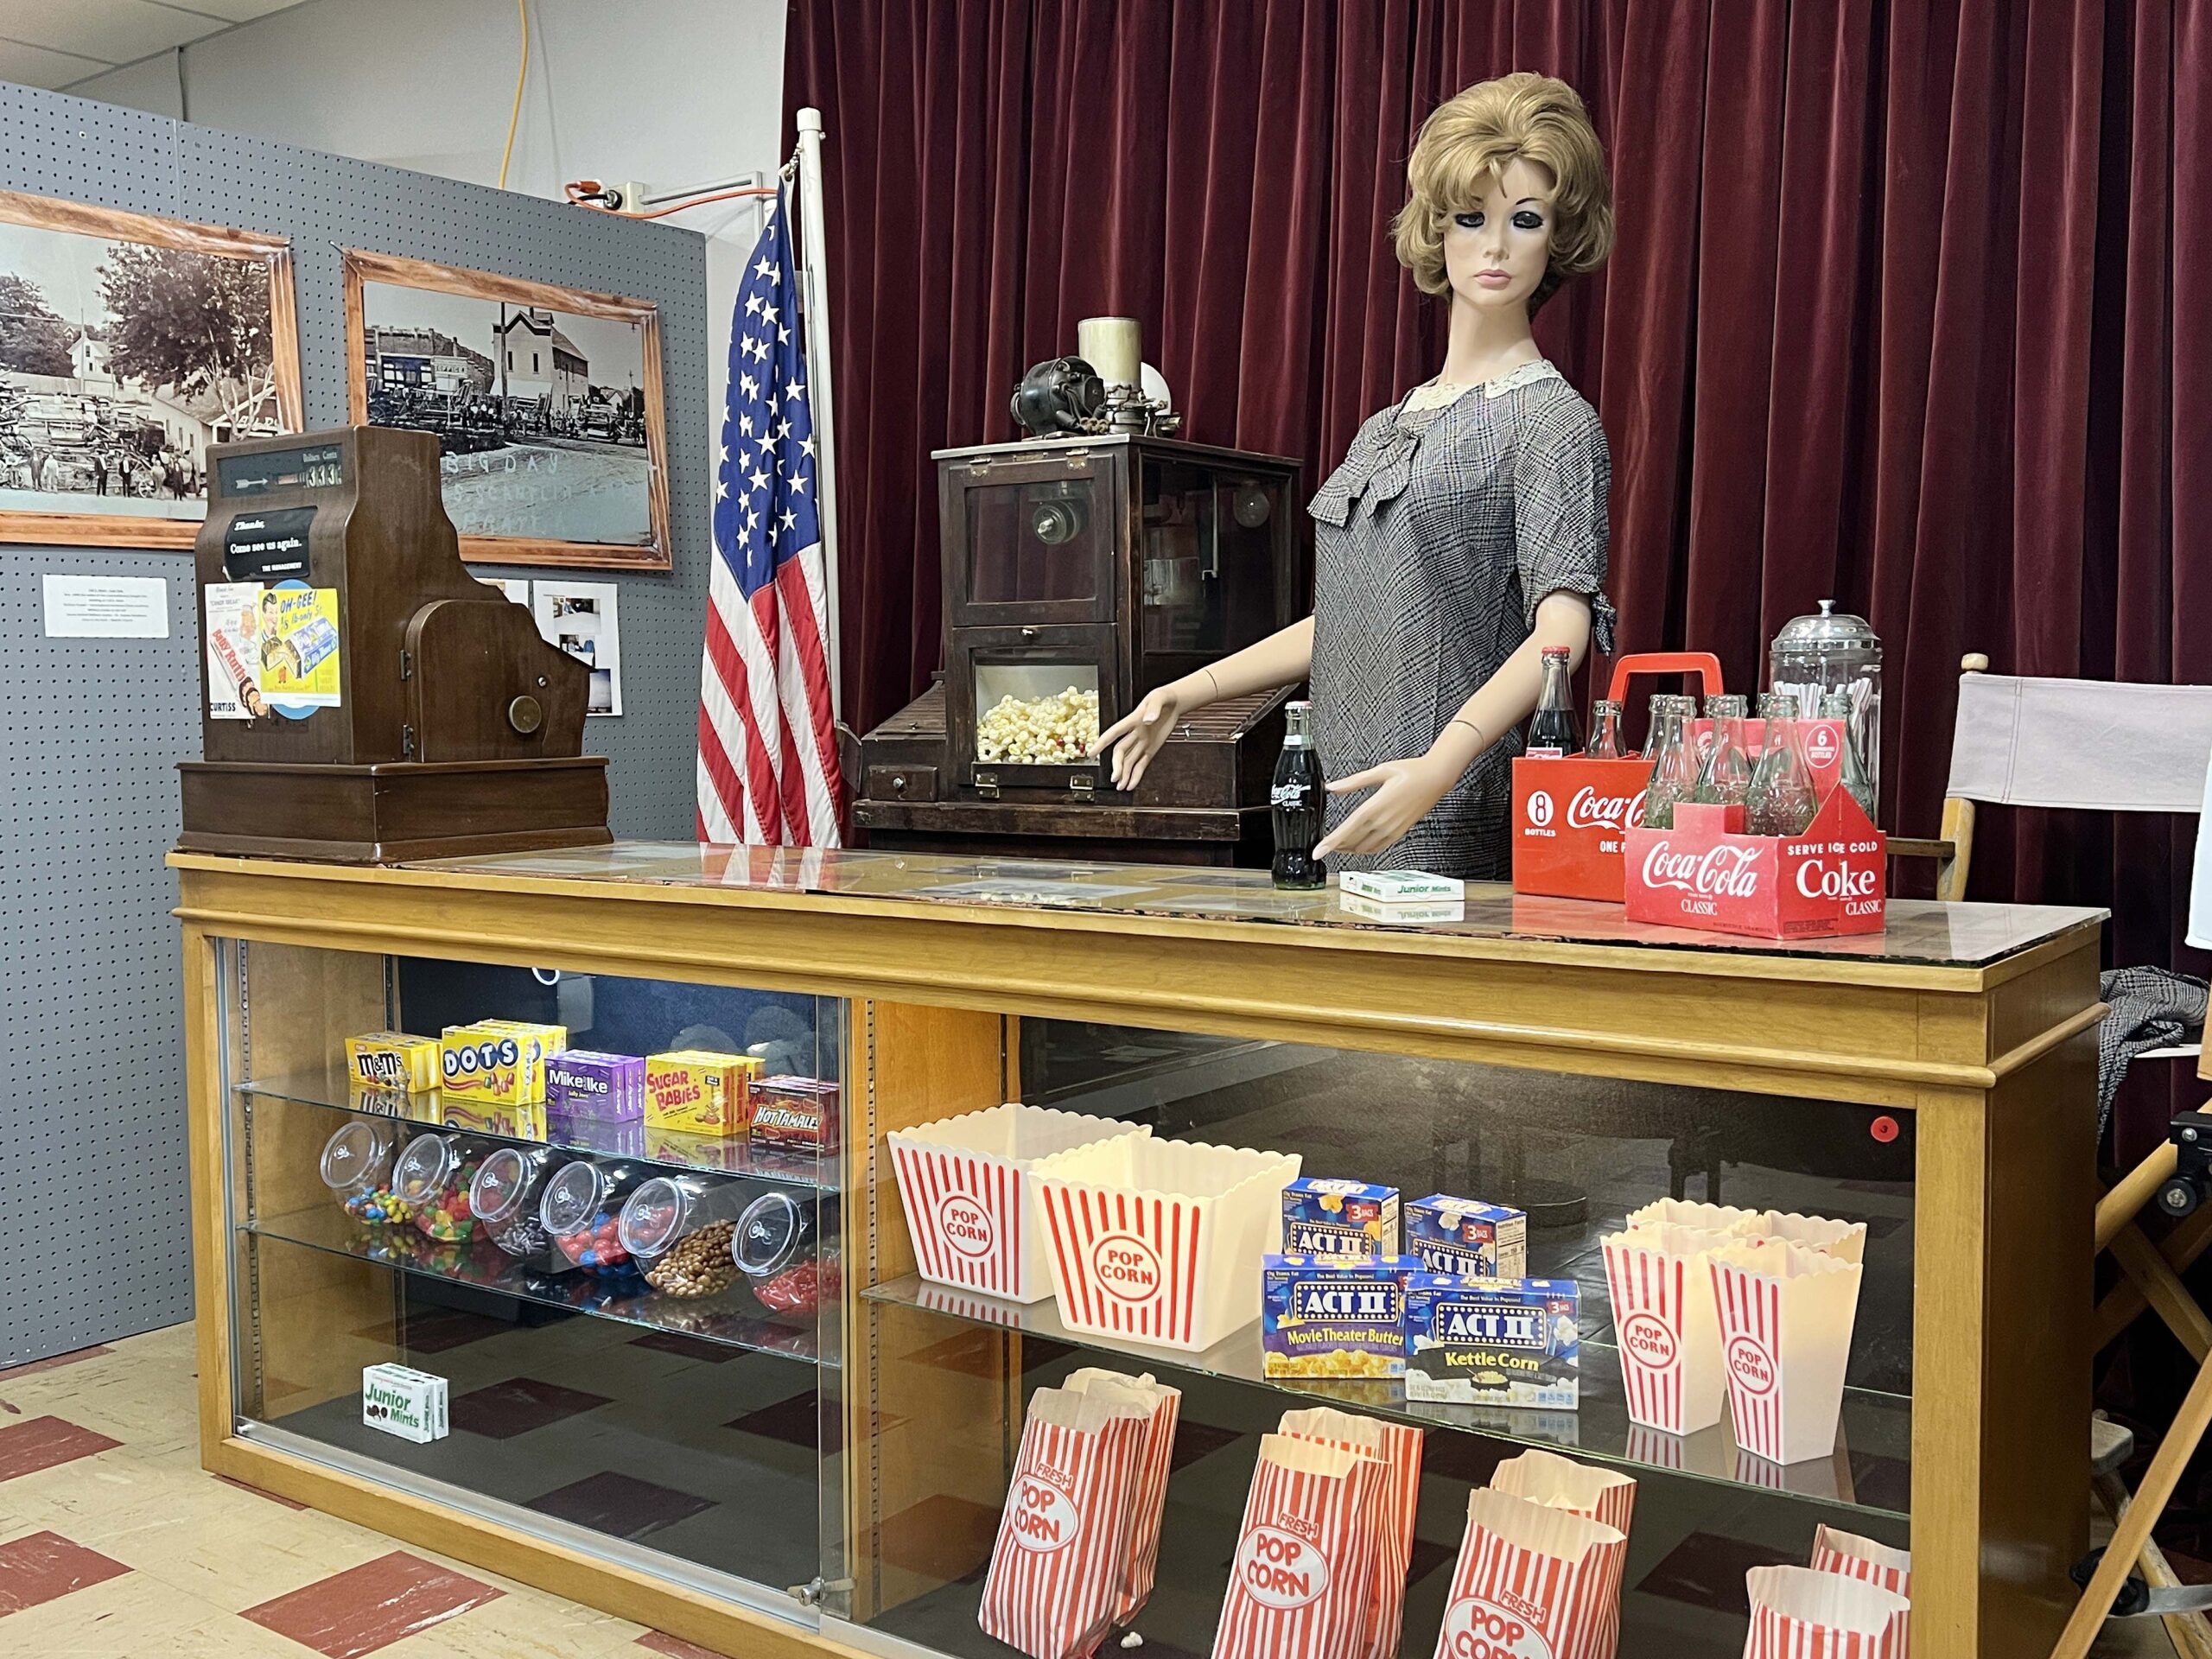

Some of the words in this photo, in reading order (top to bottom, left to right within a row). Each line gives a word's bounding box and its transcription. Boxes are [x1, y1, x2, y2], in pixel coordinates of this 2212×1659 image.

[445, 451, 489, 474] BIG
[505, 452, 558, 474] DAY
[230, 543, 251, 554] Come
[251, 542, 265, 552] see
[266, 540, 276, 550] us
[276, 537, 302, 552] again.
[280, 590, 318, 613] OH-GEE!
[211, 628, 231, 654] Baby
[224, 651, 247, 683] Ruth
[210, 702, 236, 712] CURTISS
[1817, 730, 1827, 747] 6
[1535, 794, 1547, 823] 8
[1567, 785, 1647, 830] Coca-C
[1524, 828, 1556, 837] BOTTLES
[1599, 841, 1618, 854] ONE
[1787, 843, 1824, 856] SERVE
[1828, 842, 1846, 854] ICE
[1849, 841, 1878, 853] COLD
[1643, 841, 1765, 898] Coca-Cola
[1796, 859, 1876, 899] Coke
[1397, 884, 1430, 894] Junior
[1681, 898, 1718, 916] CLASSIC
[1846, 899, 1882, 916] CLASSIC
[444, 1041, 515, 1074] DOTS
[549, 1069, 583, 1089] Mike
[587, 1077, 608, 1095] Ike
[646, 1070, 689, 1094] SUGAR
[655, 1084, 701, 1112] BABIES
[754, 1106, 778, 1126] HOT
[950, 1208, 979, 1225] POP
[1351, 1205, 1362, 1220] 3
[946, 1223, 988, 1243] CORN
[1299, 1231, 1337, 1253] ACT
[1339, 1236, 1363, 1255] II
[1467, 1225, 1478, 1241] 3
[1108, 1249, 1143, 1268] POP
[1421, 1249, 1454, 1273] ACT
[1456, 1255, 1478, 1277] II
[1100, 1265, 1154, 1286] CORN
[1305, 1291, 1354, 1313] ACT
[1357, 1292, 1387, 1313] II
[1550, 1301, 1559, 1314] 3
[1287, 1328, 1323, 1346] Movie
[1322, 1327, 1368, 1342] Theater
[1368, 1328, 1404, 1346] Butter
[1447, 1313, 1500, 1338] ACT
[1503, 1315, 1534, 1339] II
[1635, 1325, 1662, 1341] POP
[1630, 1337, 1670, 1357] CORN
[1738, 1348, 1762, 1365] POP
[1445, 1351, 1493, 1368] Kettle
[1497, 1352, 1540, 1372] Corn
[1733, 1360, 1769, 1382] CORN
[365, 1383, 411, 1411] Junior
[390, 1408, 420, 1428] Mints
[1036, 1462, 1074, 1491] FRESH
[1020, 1489, 1054, 1514] POP
[1014, 1511, 1060, 1543] CORN
[1277, 1512, 1319, 1539] FRESH
[1256, 1533, 1301, 1567] POP
[1247, 1562, 1310, 1599] CORN
[1499, 1590, 1546, 1624] FRESH
[1471, 1605, 1524, 1647] POP
